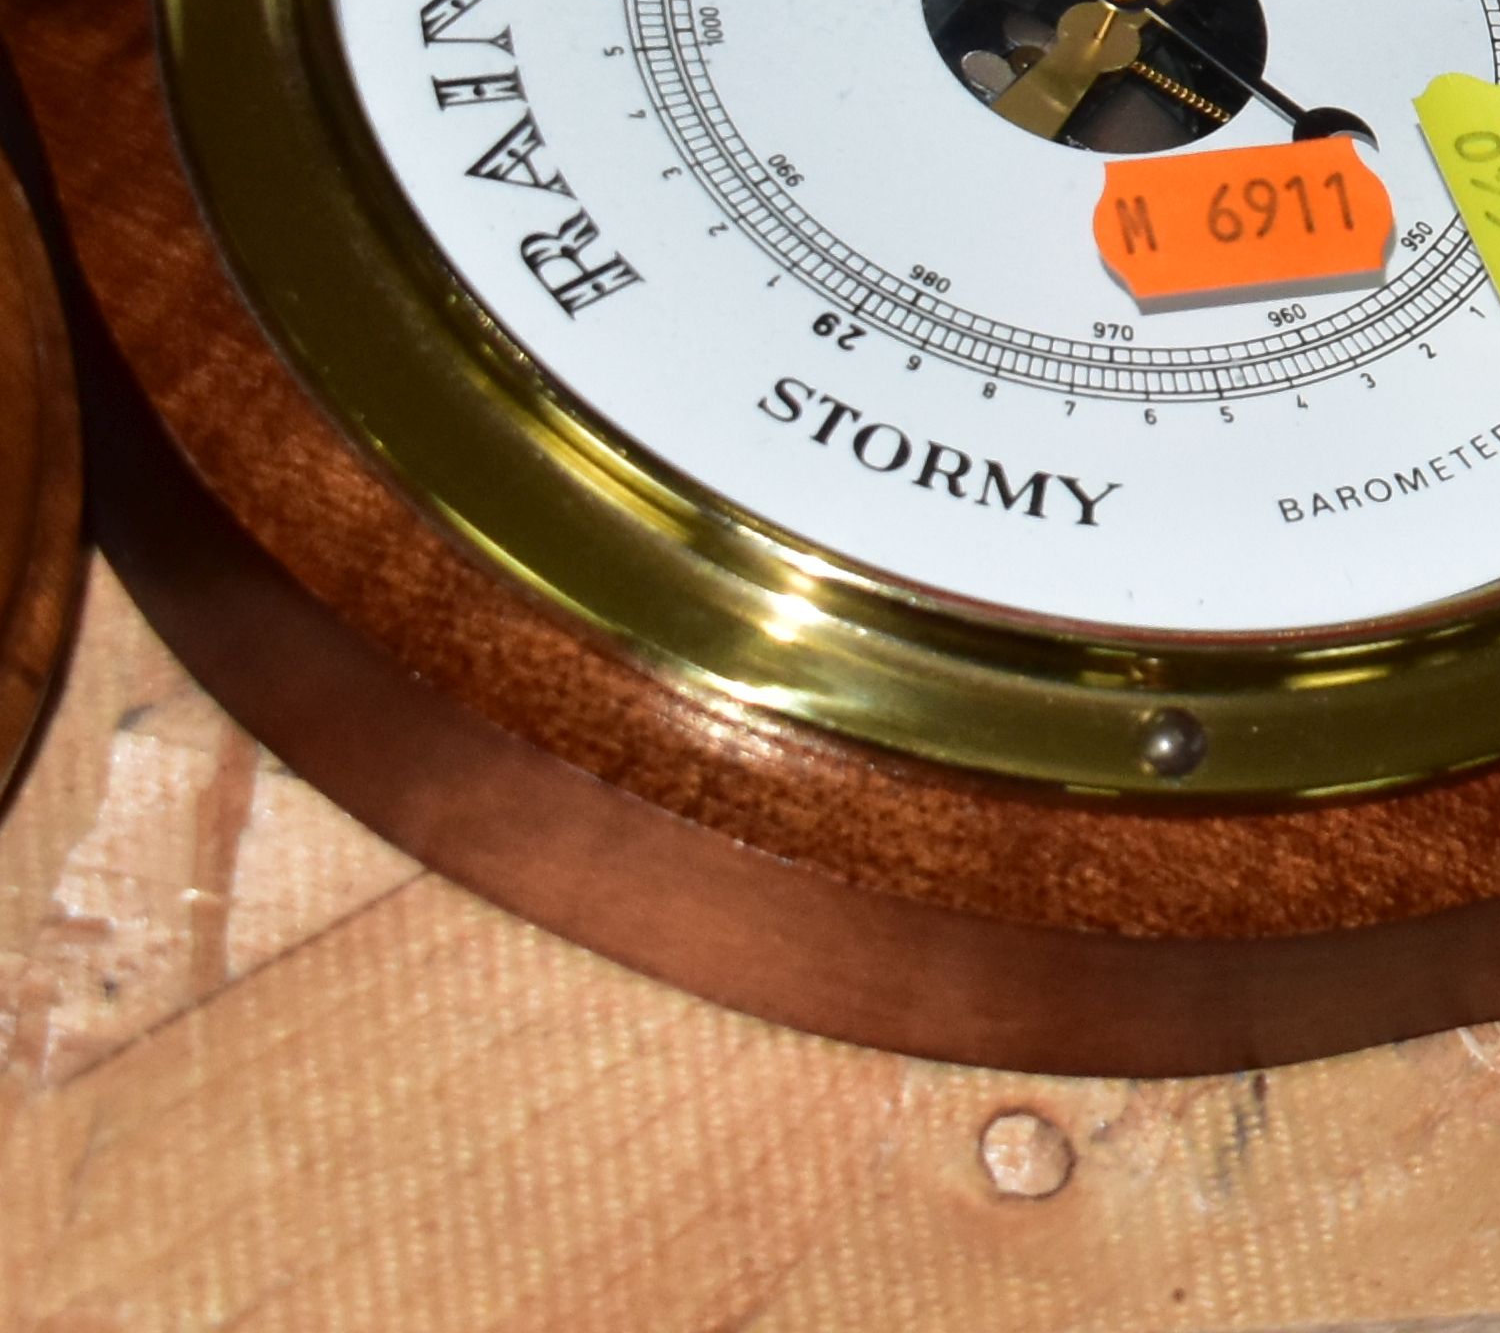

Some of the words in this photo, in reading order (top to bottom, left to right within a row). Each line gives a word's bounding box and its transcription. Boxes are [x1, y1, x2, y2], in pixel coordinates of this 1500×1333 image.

[699, 6, 725, 46] 1000
[768, 154, 805, 188] 990
[1207, 171, 1354, 243] 6911
[1400, 221, 1434, 252] 950
[908, 263, 952, 294] 980
[1267, 303, 1308, 328] 960
[812, 311, 867, 352] 29
[1092, 321, 1134, 342] 970
[982, 382, 997, 400] 8
[1064, 399, 1077, 418] 7
[1144, 407, 1157, 426] 6
[1219, 405, 1235, 424] 5
[755, 376, 1123, 528] STORMY
